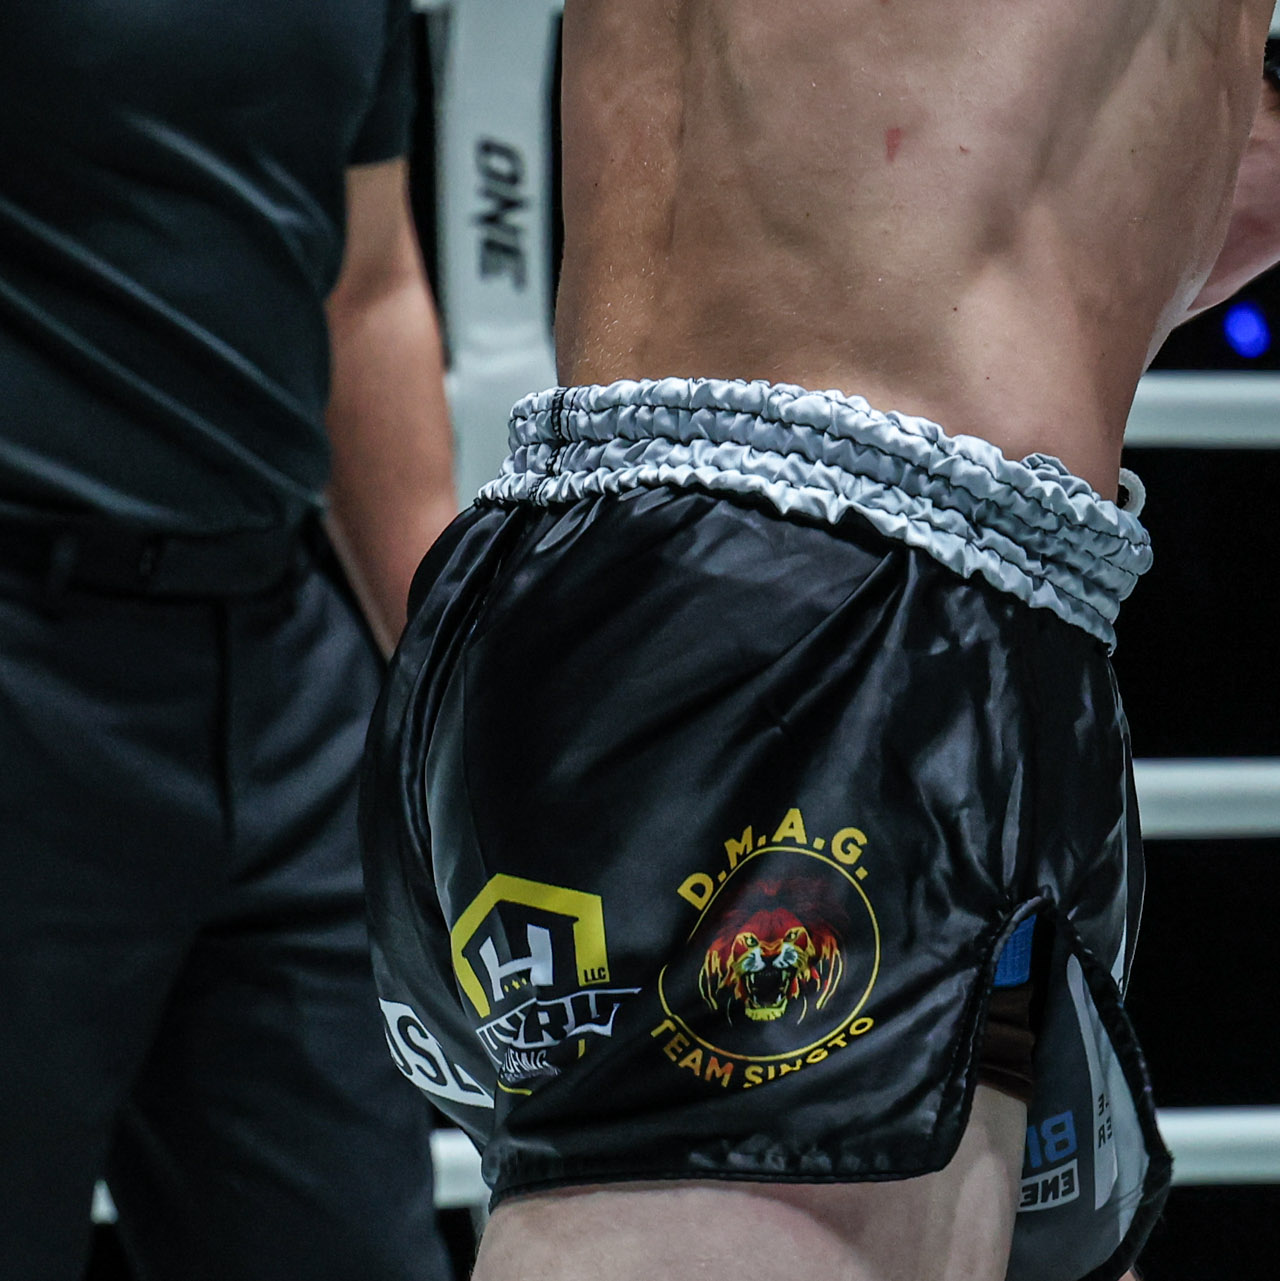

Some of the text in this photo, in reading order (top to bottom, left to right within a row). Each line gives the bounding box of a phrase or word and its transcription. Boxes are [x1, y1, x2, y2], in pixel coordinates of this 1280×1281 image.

[473, 137, 530, 294] ONE
[677, 808, 869, 910] D.M.A.G.
[584, 967, 607, 983] LLC
[650, 1019, 735, 1088] TEAM
